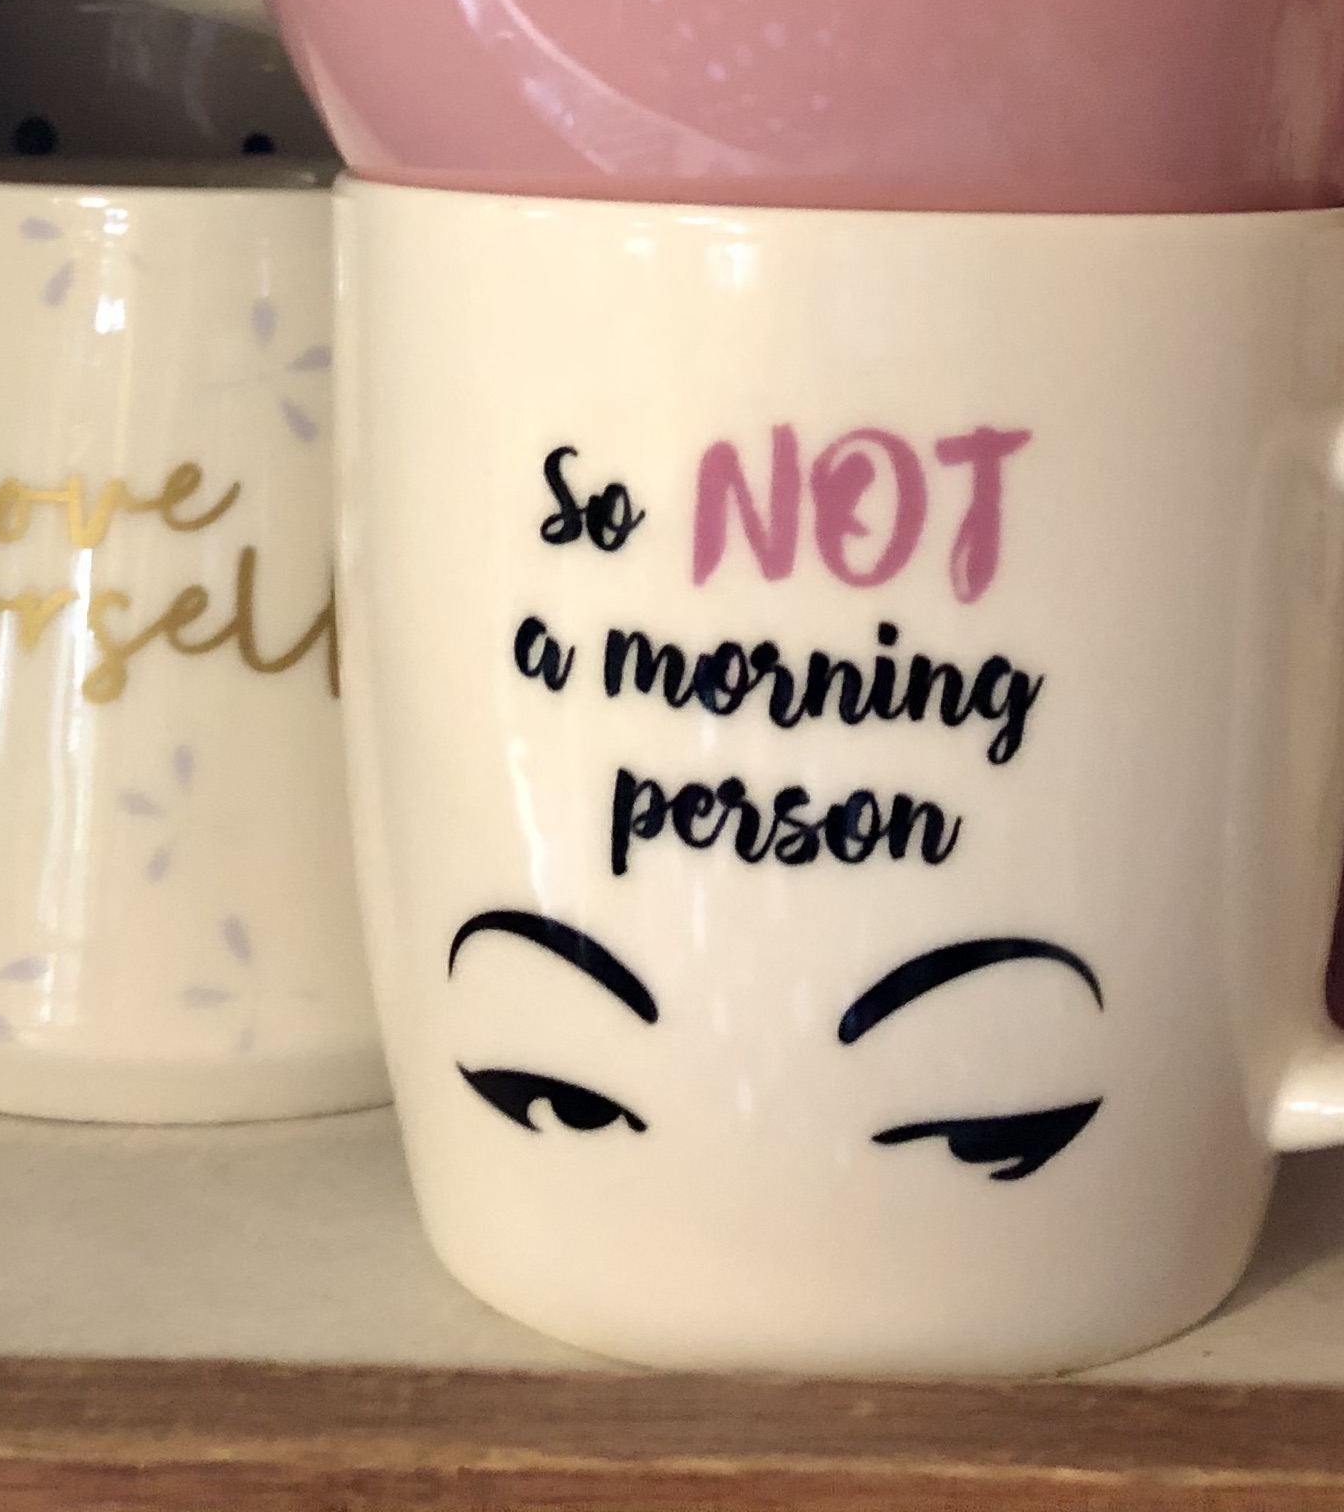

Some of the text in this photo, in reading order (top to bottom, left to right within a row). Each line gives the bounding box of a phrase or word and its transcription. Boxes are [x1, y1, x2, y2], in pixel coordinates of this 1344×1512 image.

[540, 423, 1033, 605] So NOT
[513, 615, 1046, 765] a morning
[611, 767, 963, 877] person
